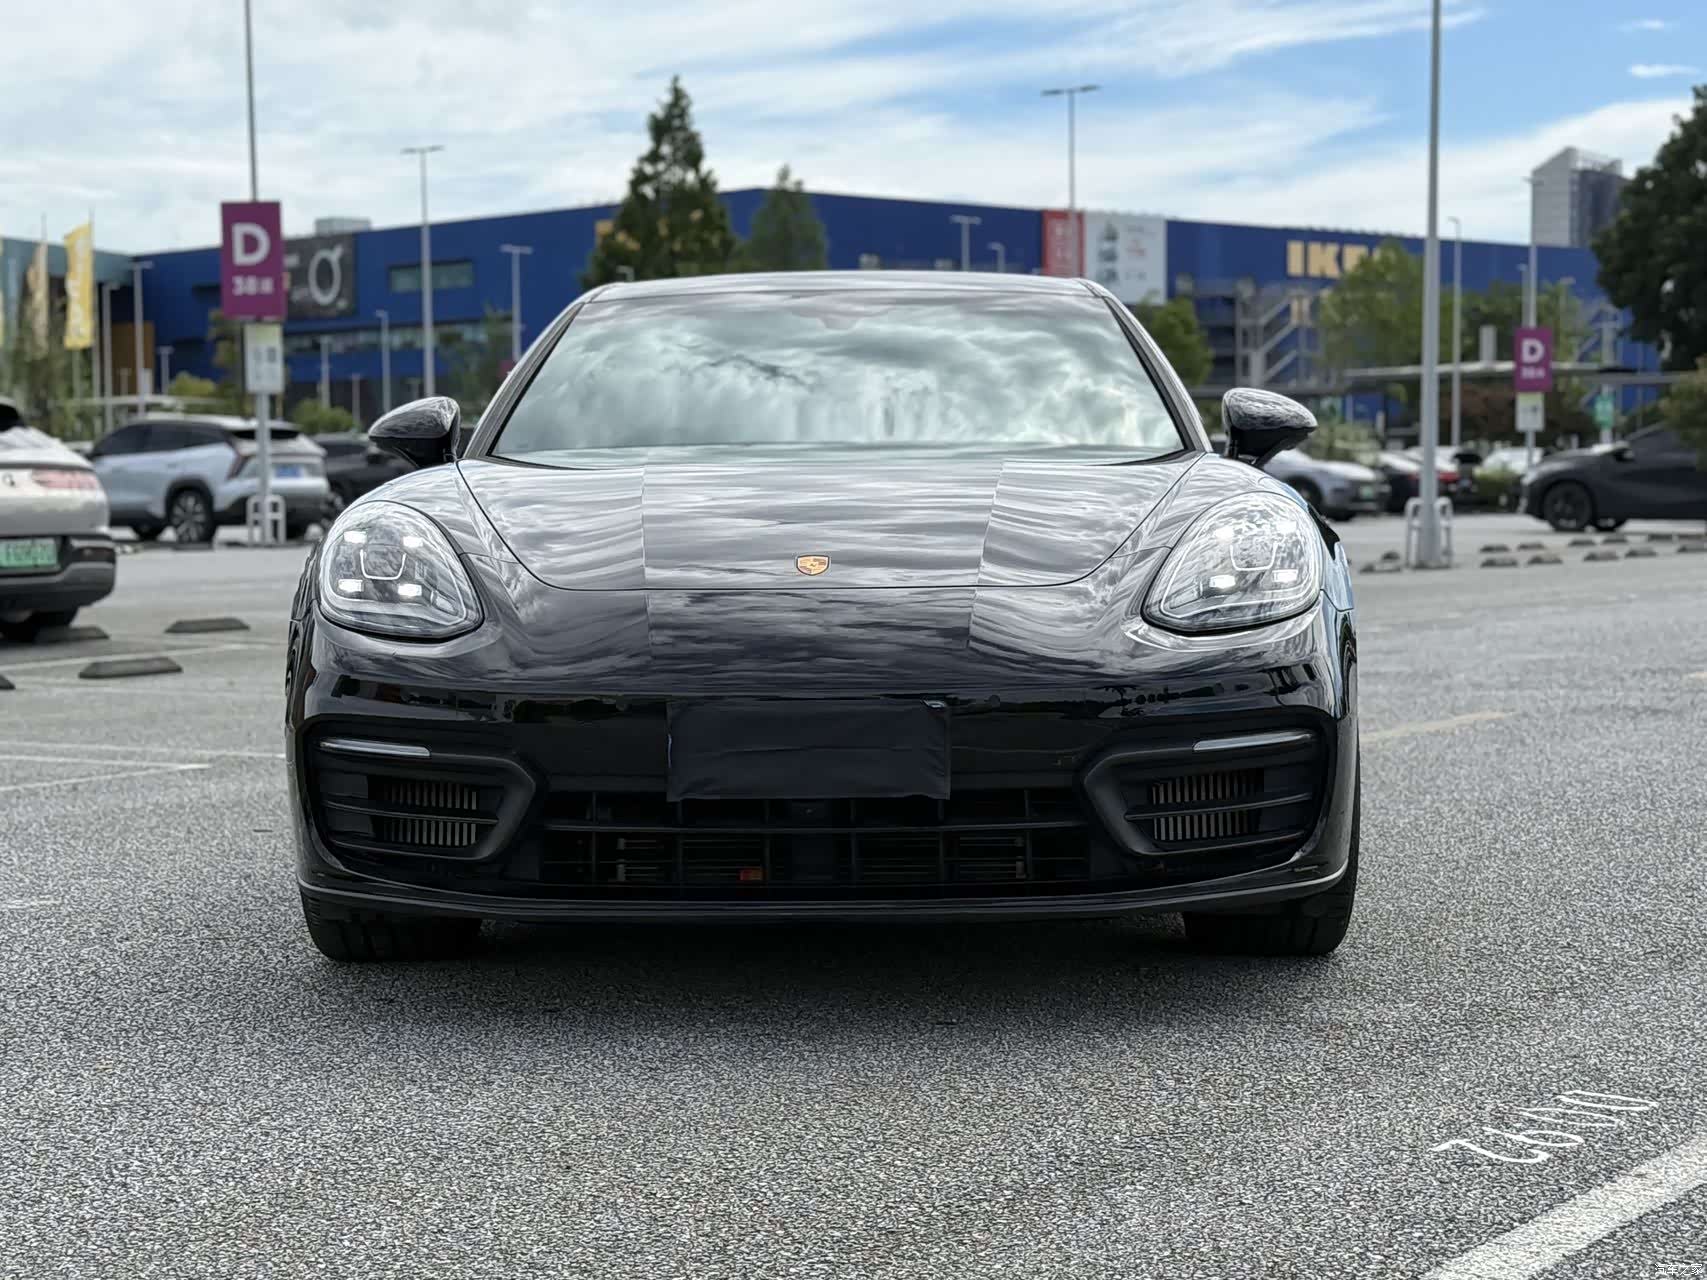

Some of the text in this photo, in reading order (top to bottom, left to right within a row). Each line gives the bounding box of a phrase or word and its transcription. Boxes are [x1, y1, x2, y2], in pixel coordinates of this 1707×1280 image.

[231, 222, 271, 267] D
[1287, 240, 1397, 279] IKE
[1521, 337, 1545, 364] D
